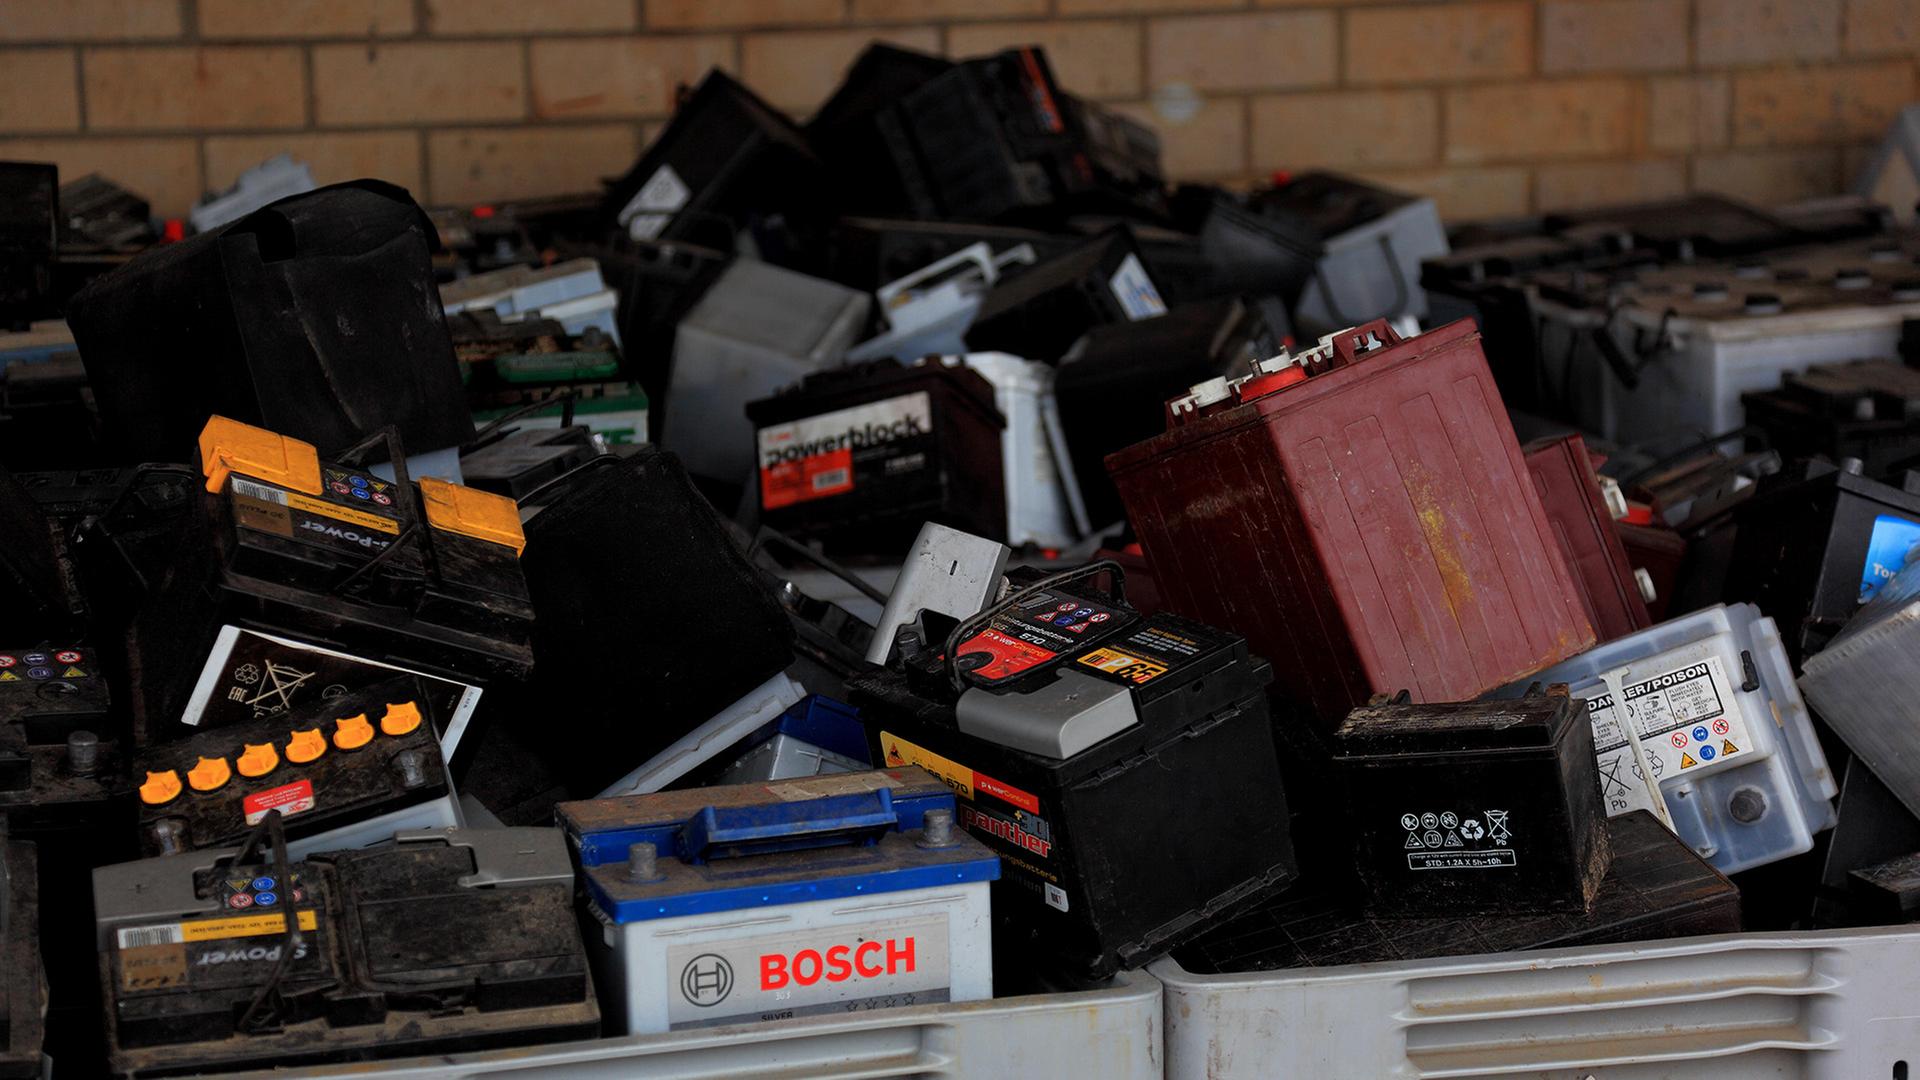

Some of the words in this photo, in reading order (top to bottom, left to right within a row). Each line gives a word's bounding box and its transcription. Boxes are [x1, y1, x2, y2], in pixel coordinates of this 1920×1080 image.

[767, 415, 920, 468] powerblock
[1019, 632, 1046, 645] 570
[1588, 664, 1708, 710] DANER/POISON
[946, 777, 968, 794] 570
[1612, 800, 1628, 811] Pb
[960, 803, 1051, 858] panther
[197, 944, 307, 966] SPower
[760, 937, 915, 990] BOSCH
